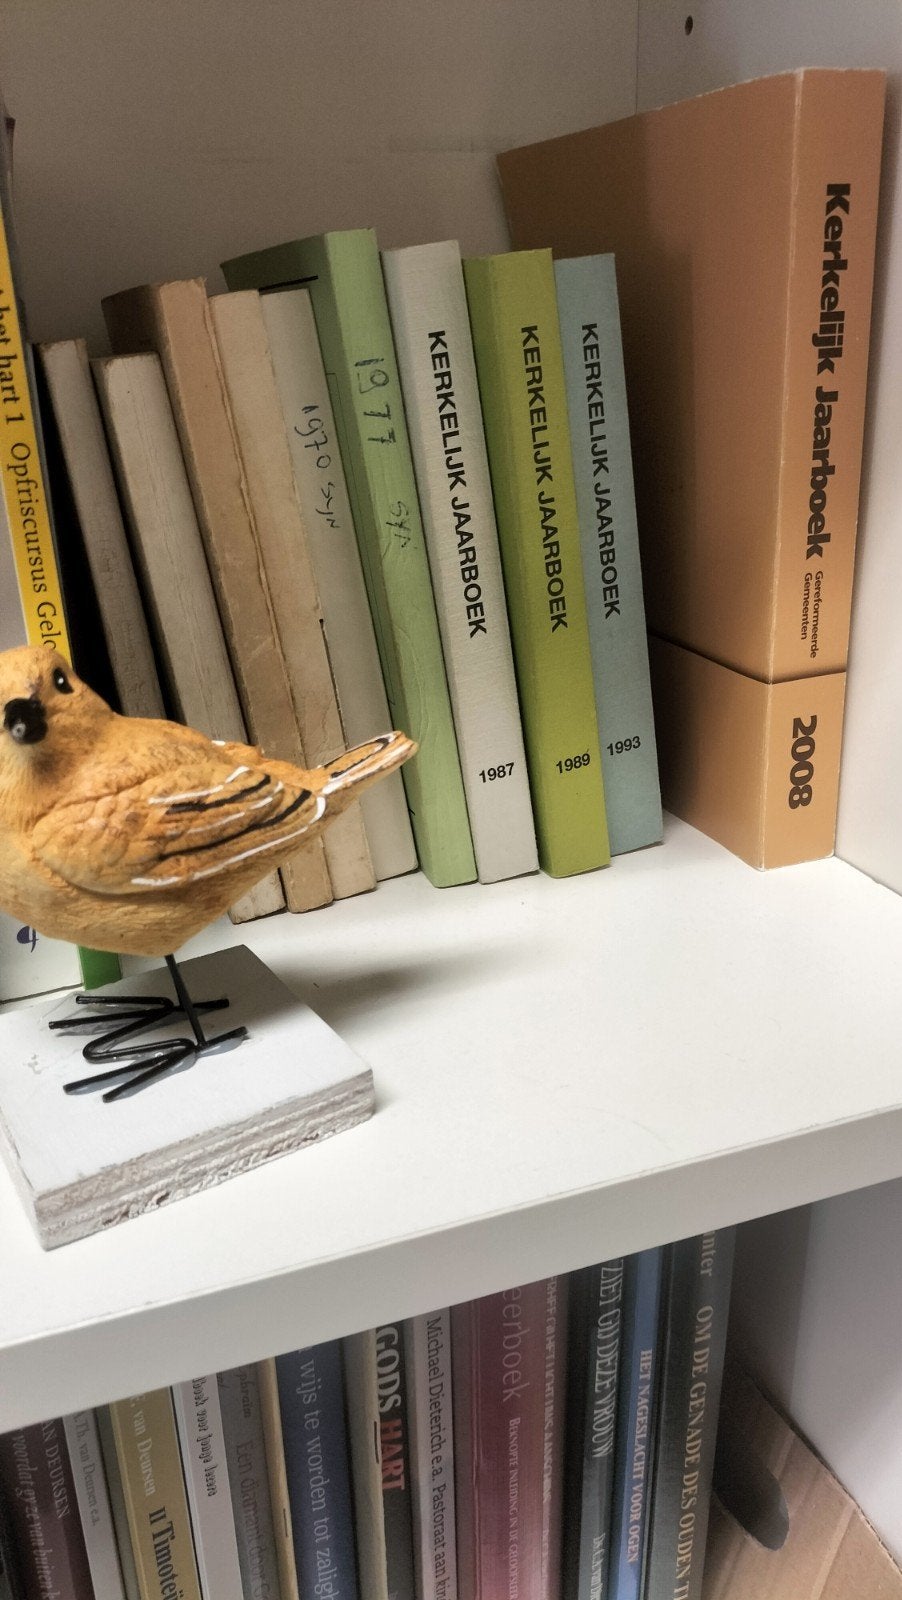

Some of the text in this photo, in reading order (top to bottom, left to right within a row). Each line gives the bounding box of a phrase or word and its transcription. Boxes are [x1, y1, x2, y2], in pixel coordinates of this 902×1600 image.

[0, 354, 20, 404] hart
[355, 358, 397, 445] 1977
[806, 183, 851, 560] Kerkelijk Jaarboek
[6, 412, 25, 425] 1
[428, 330, 488, 639] KERKELIJK JAARBOEK
[520, 325, 570, 634] KERKELIJK JAARBOEK
[581, 323, 622, 620] KERKELIJK JAARBOEK
[10, 442, 49, 593] Opfriscursus
[799, 571, 813, 641] Gemeenten
[809, 570, 824, 659] Gereformeerde
[478, 762, 516, 785] 1987
[555, 753, 592, 775] 1989
[606, 736, 642, 757] 1993
[788, 715, 818, 810] 2008
[597, 1261, 623, 1307] ZIET
[426, 1316, 444, 1382] Michael
[695, 1305, 713, 1342] OM
[297, 1359, 321, 1404] wijs
[593, 1340, 617, 1393] DEZE
[692, 1347, 710, 1378] DE
[131, 1411, 147, 1437] van
[303, 1410, 320, 1430] te
[376, 1327, 406, 1491] GODS HART
[428, 1382, 448, 1452] Dieterich
[590, 1394, 615, 1458] VROUW
[684, 1382, 708, 1468] GENADE
[45, 1443, 72, 1520] DEURSEN
[79, 1442, 92, 1463] van
[136, 1438, 157, 1498] Deursen
[237, 1441, 255, 1474] Een
[304, 1436, 331, 1512] worden
[430, 1455, 443, 1481] e.a.
[626, 1349, 653, 1563] HET NAGESLACHT VOOR OGEN
[82, 1462, 100, 1505] Deursen
[679, 1470, 699, 1510] DES
[313, 1516, 331, 1542] tot
[432, 1484, 451, 1551] Pastoraat
[676, 1512, 695, 1580] OUDEN
[434, 1552, 447, 1577] aan
